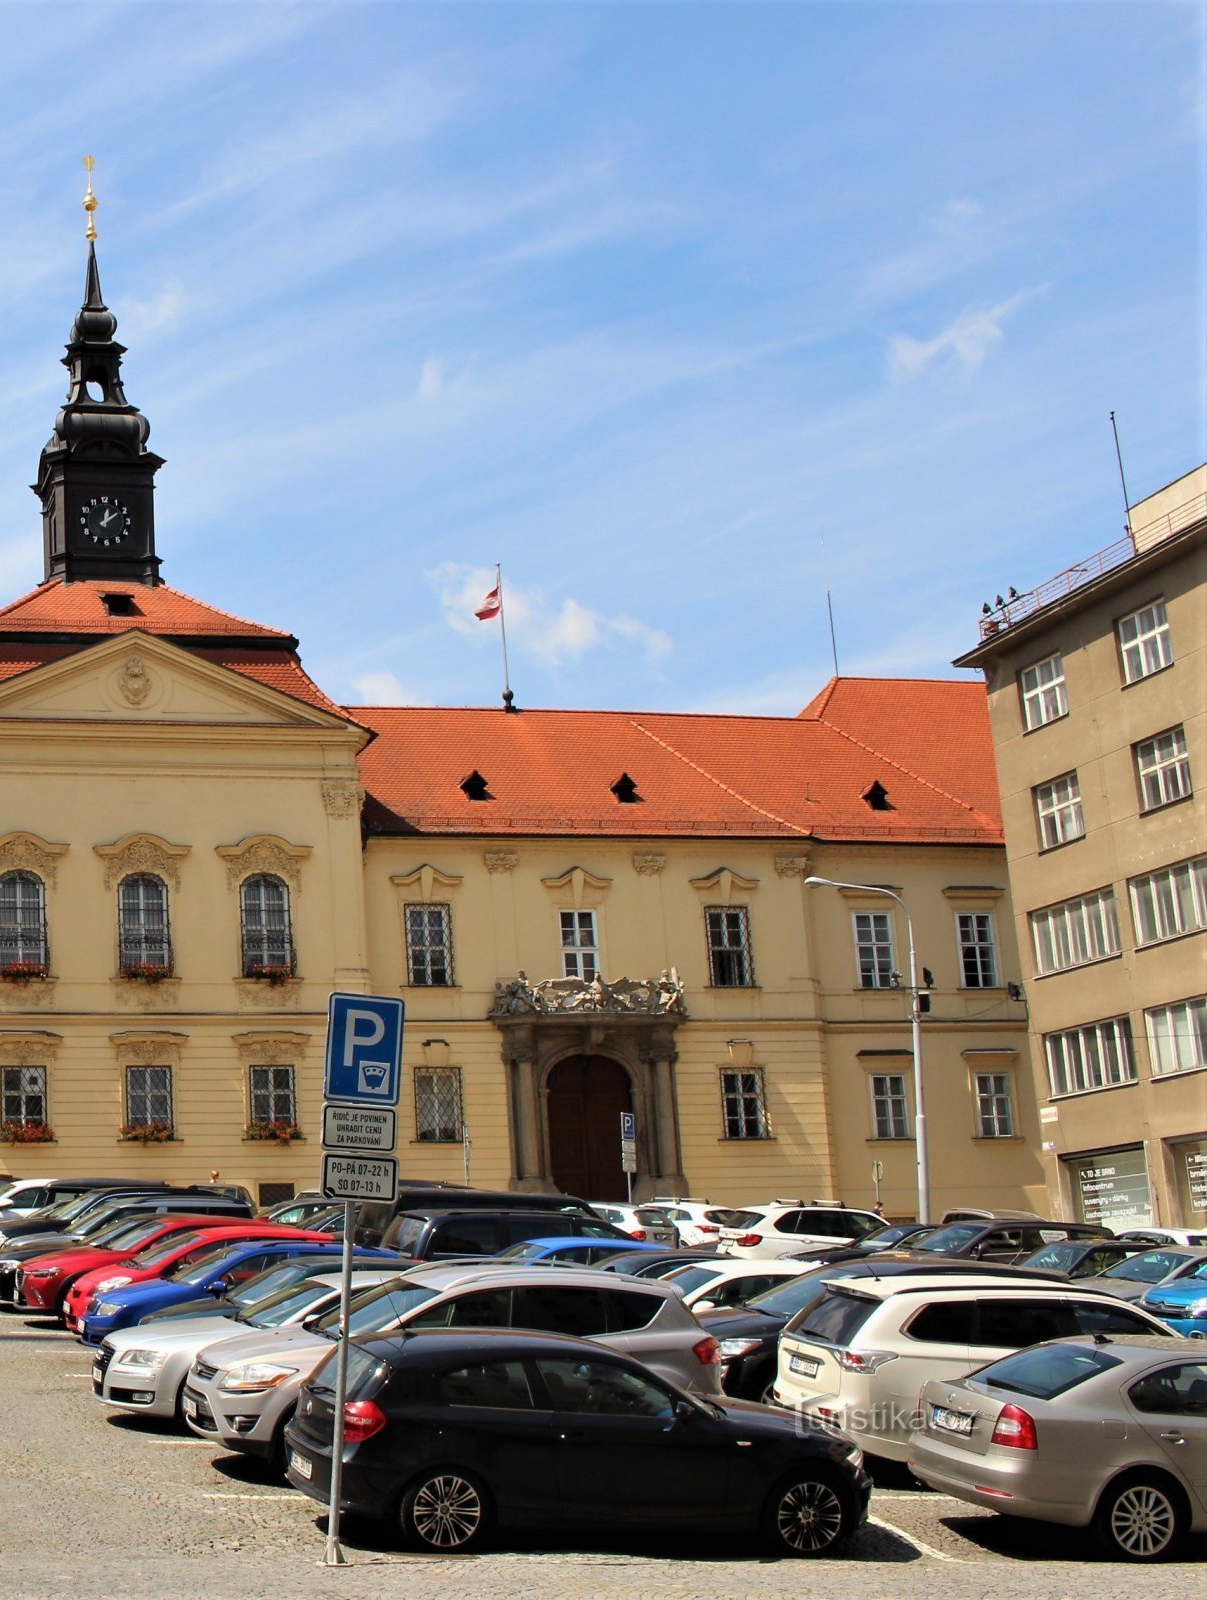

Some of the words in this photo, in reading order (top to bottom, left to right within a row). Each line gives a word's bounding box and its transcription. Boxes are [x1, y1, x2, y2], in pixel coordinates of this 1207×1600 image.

[343, 1008, 385, 1067] P
[332, 1110, 350, 1121] ŘIDIČ
[351, 1113, 359, 1121] JE
[360, 1114, 388, 1124] POVINEN
[624, 1116, 632, 1132] P
[336, 1123, 363, 1133] UHRADIT
[365, 1125, 382, 1134] CENU
[336, 1134, 345, 1143] ZA
[346, 1135, 381, 1146] PARKOVÁNÍ
[331, 1161, 356, 1174] PO-PÁ
[358, 1164, 382, 1177] 07-22
[383, 1166, 389, 1177] h
[337, 1179, 349, 1190] SO
[350, 1180, 374, 1192] 07-13
[375, 1182, 381, 1193] h
